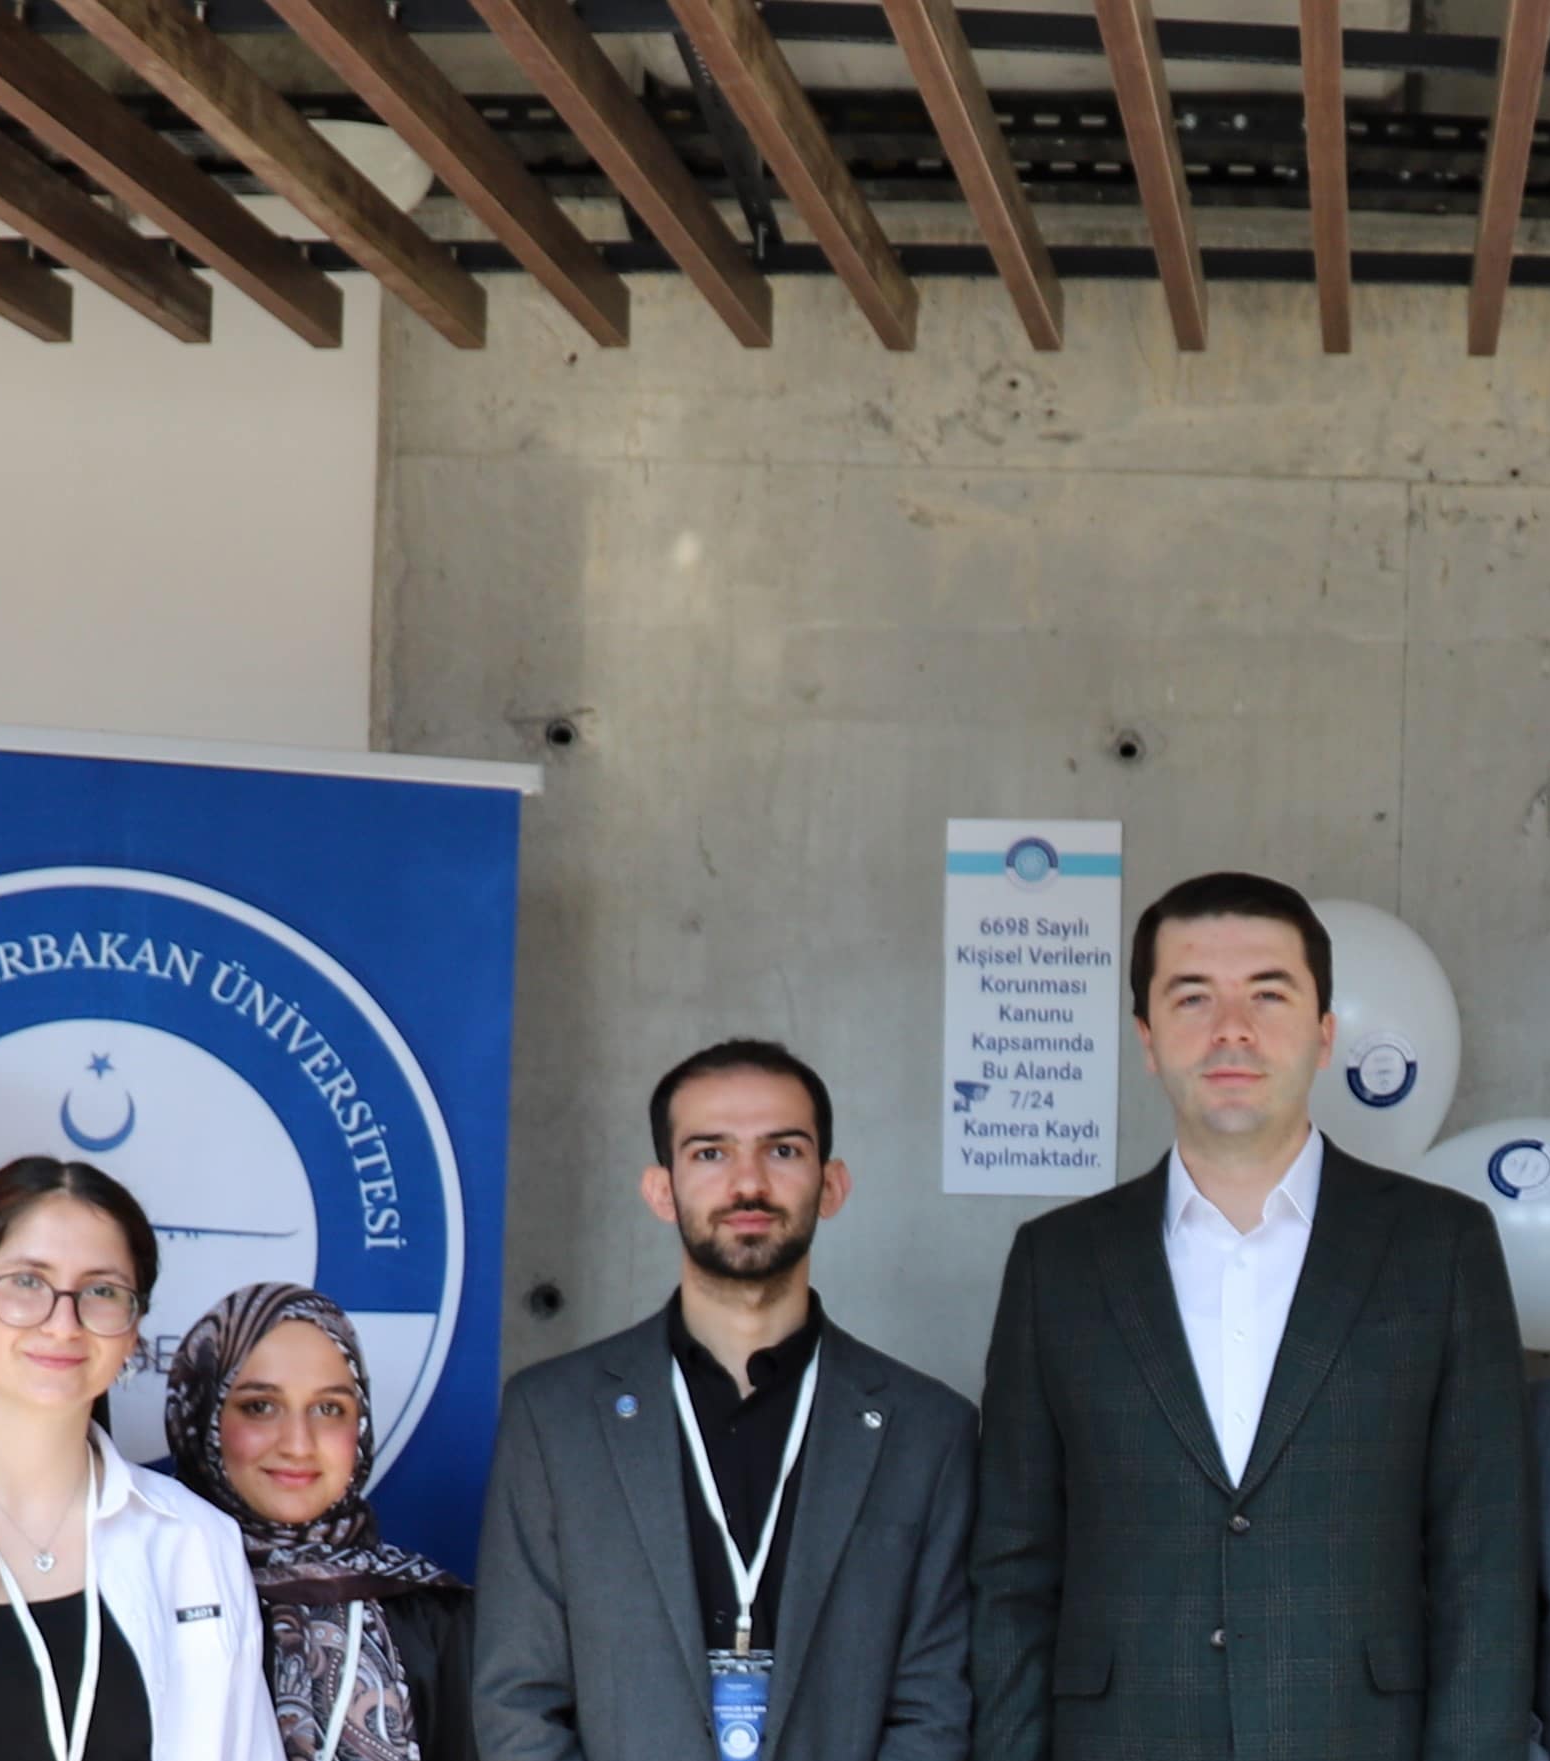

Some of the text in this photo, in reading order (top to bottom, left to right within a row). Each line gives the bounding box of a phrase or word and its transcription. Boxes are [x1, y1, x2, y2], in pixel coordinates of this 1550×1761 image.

[979, 917, 1090, 943] 6698 Sayılı
[956, 946, 1112, 969] Kişisel Verilerin
[980, 975, 1088, 995] Korunması
[998, 1004, 1074, 1023] Kanunu
[971, 1032, 1095, 1056] Kapsamında
[982, 1061, 1083, 1081] Bu Alanda
[209, 961, 407, 1251] ÜNİVERSİTESİ
[1009, 1090, 1055, 1109] 7/24
[962, 1119, 1100, 1143] Kamera Kaydı
[961, 1147, 1102, 1170] Yapılmaktadır.
